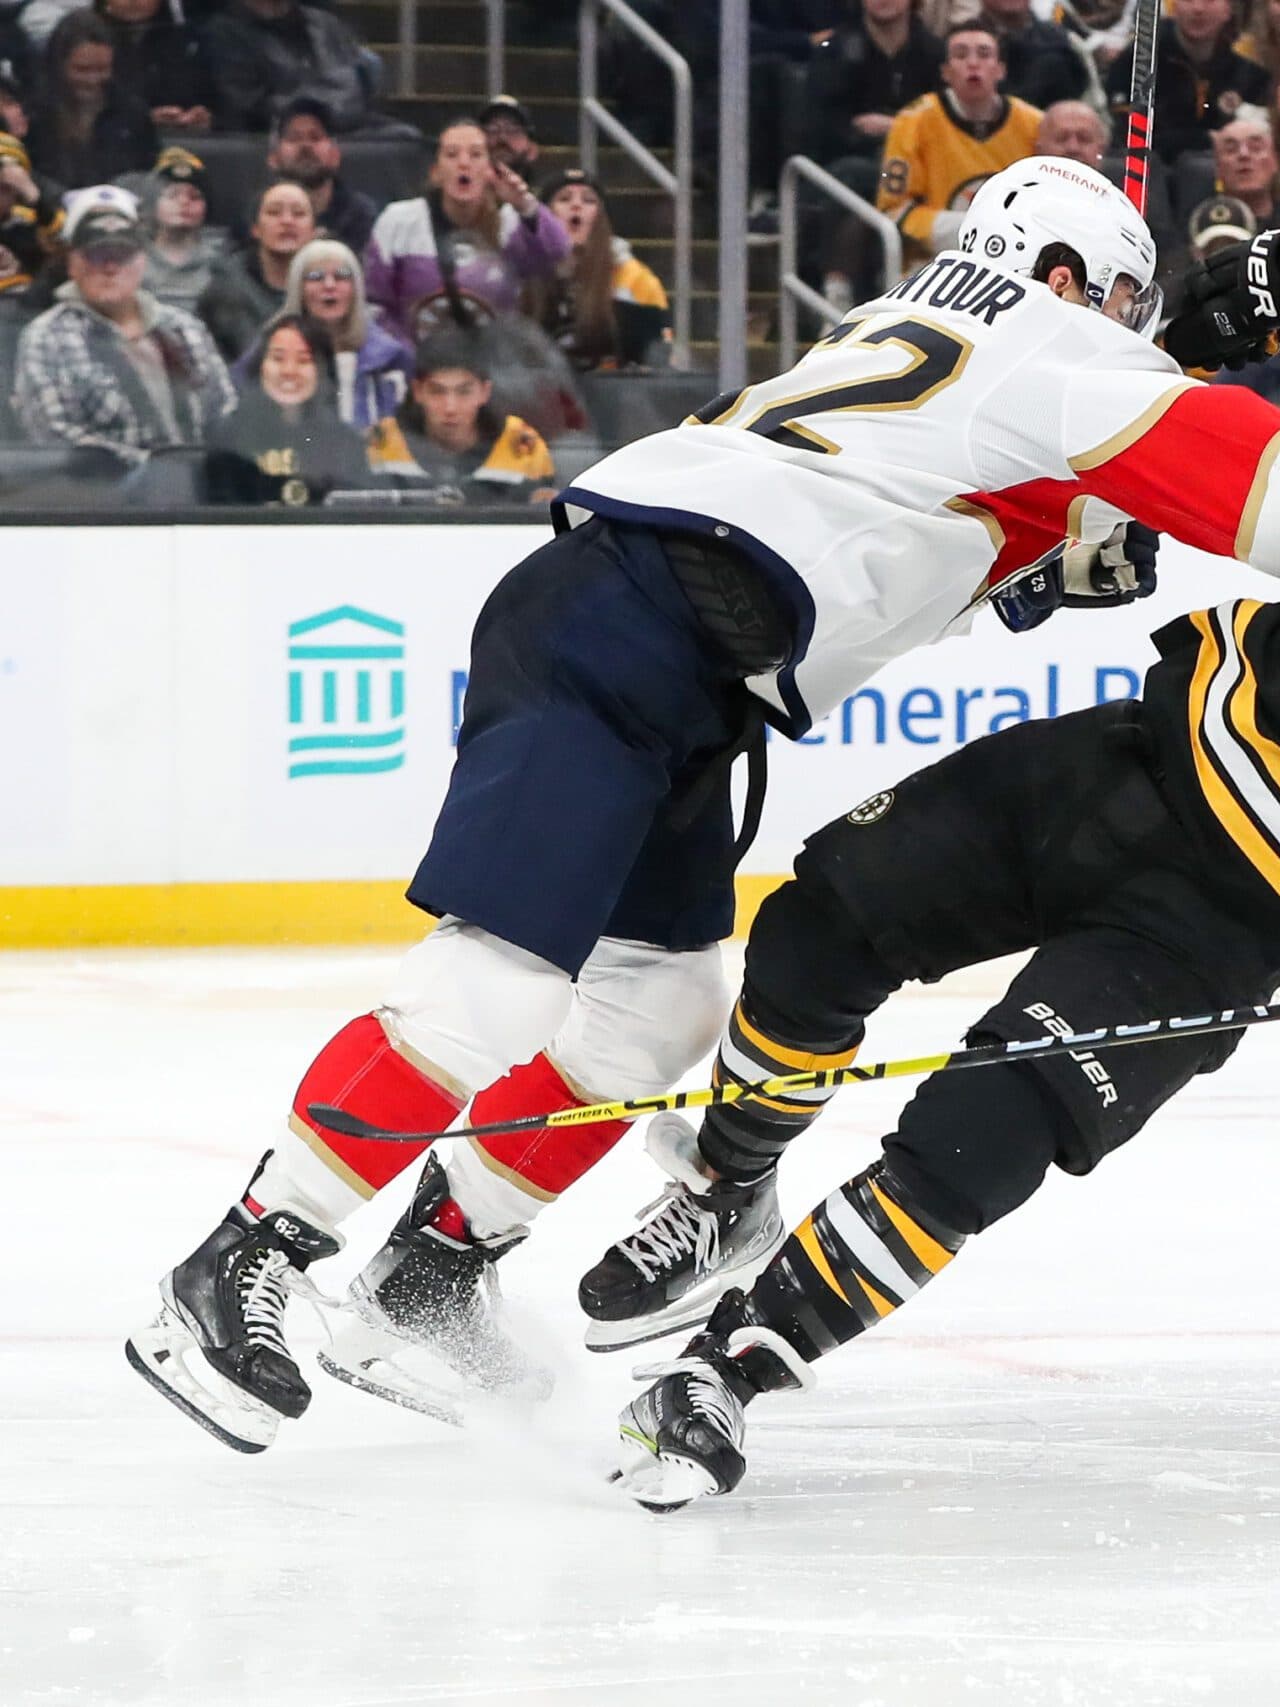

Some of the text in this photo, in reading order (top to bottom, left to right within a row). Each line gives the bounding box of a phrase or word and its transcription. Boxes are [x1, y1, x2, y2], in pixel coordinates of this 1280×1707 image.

[1039, 163, 1109, 197] AMERANT
[1031, 573, 1046, 593] 62
[273, 1216, 301, 1241] 62
